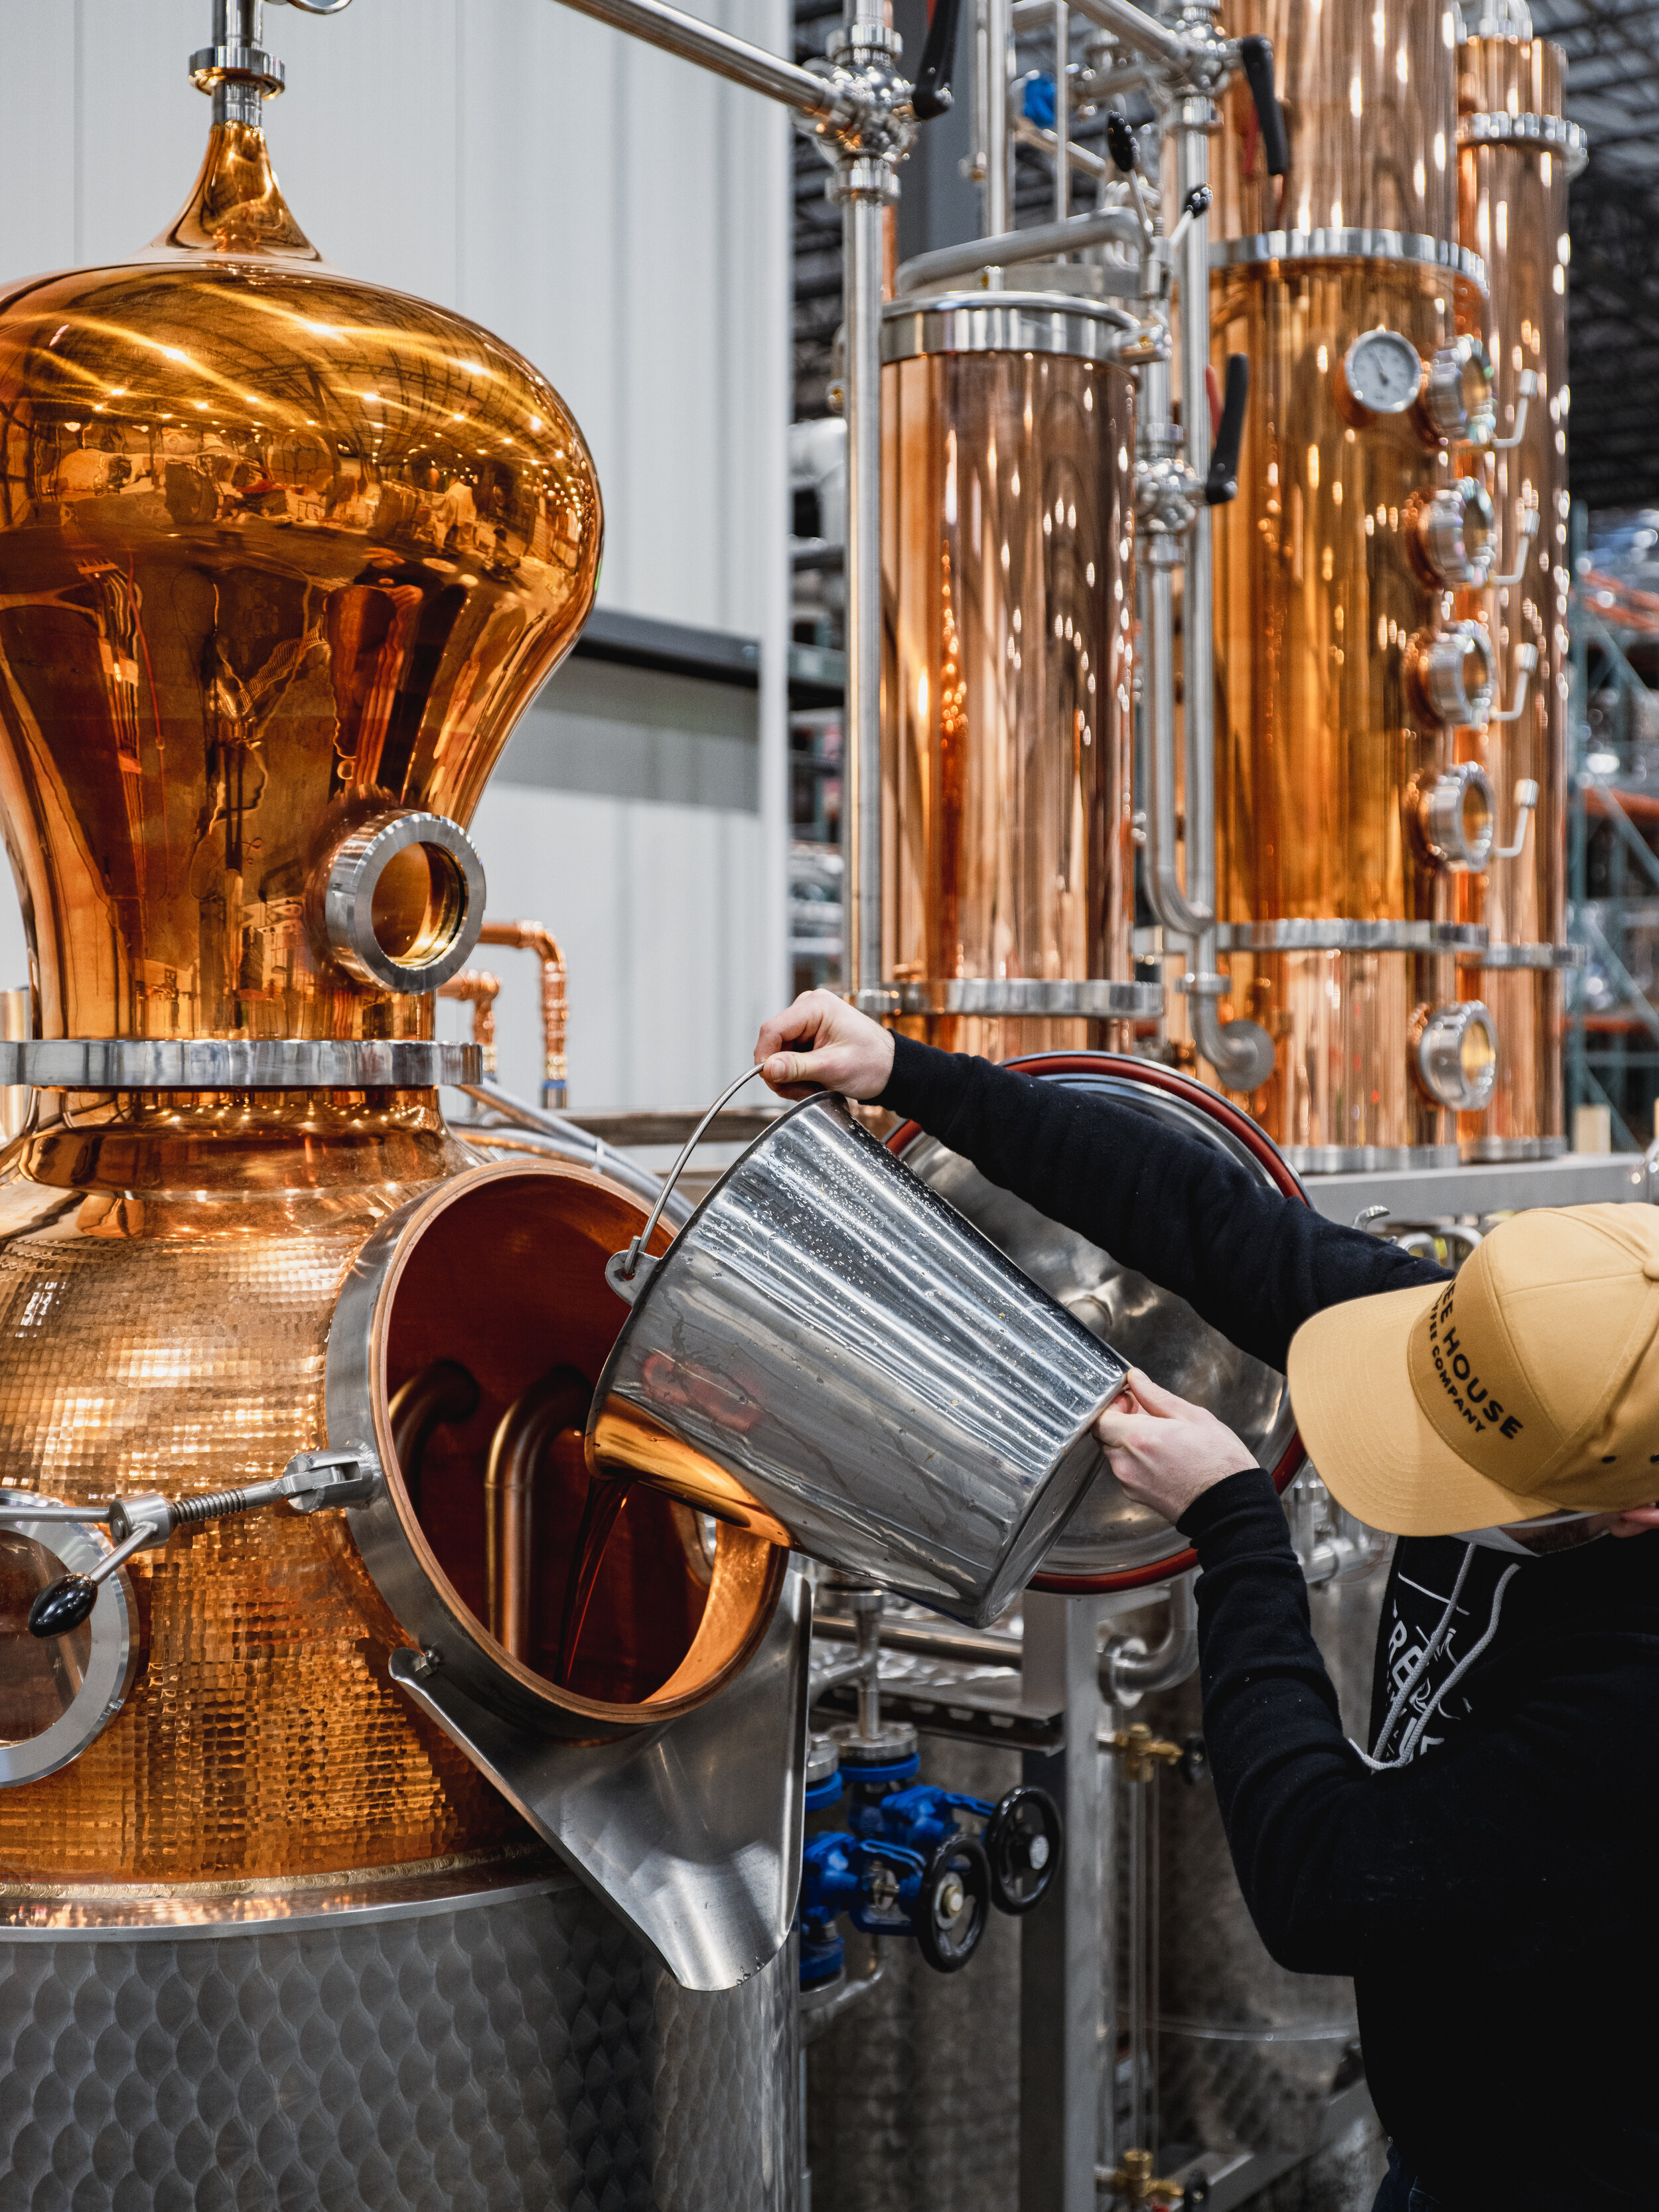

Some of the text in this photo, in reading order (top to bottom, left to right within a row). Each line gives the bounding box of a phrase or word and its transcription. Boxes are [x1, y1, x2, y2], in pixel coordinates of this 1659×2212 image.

[1432, 1345, 1486, 1433] COMPANY
[1441, 1282, 1524, 1439] EE HOUSE
